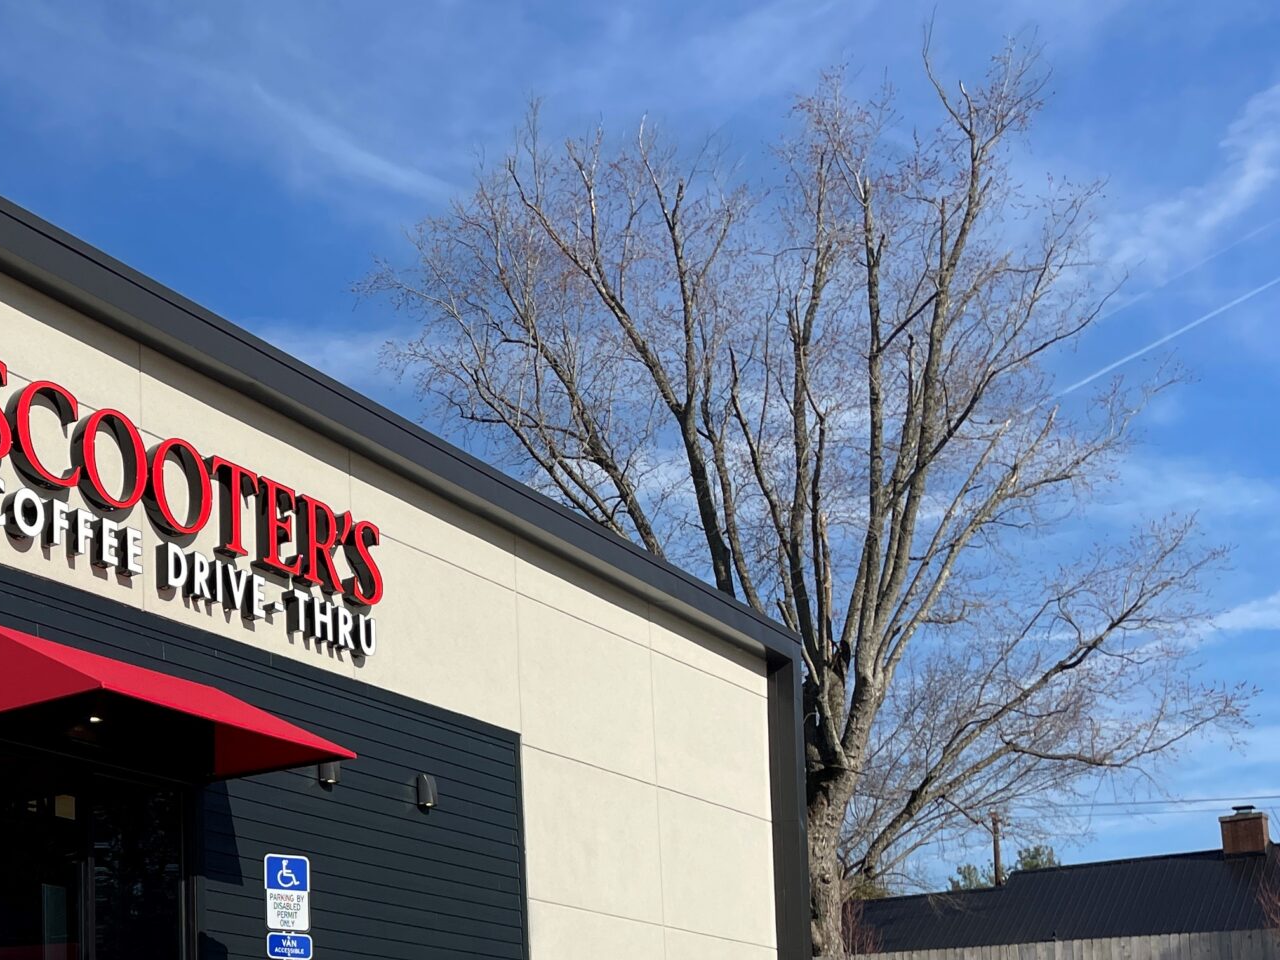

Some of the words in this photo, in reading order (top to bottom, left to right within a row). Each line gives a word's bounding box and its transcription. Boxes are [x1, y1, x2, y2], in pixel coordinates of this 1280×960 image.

[167, 543, 377, 656] DRIVE-THRU
[269, 893, 294, 903] PARKING
[297, 894, 304, 903] BY
[274, 902, 301, 911] DISABLED
[277, 911, 297, 919] PERMIT
[281, 939, 297, 948] VAN
